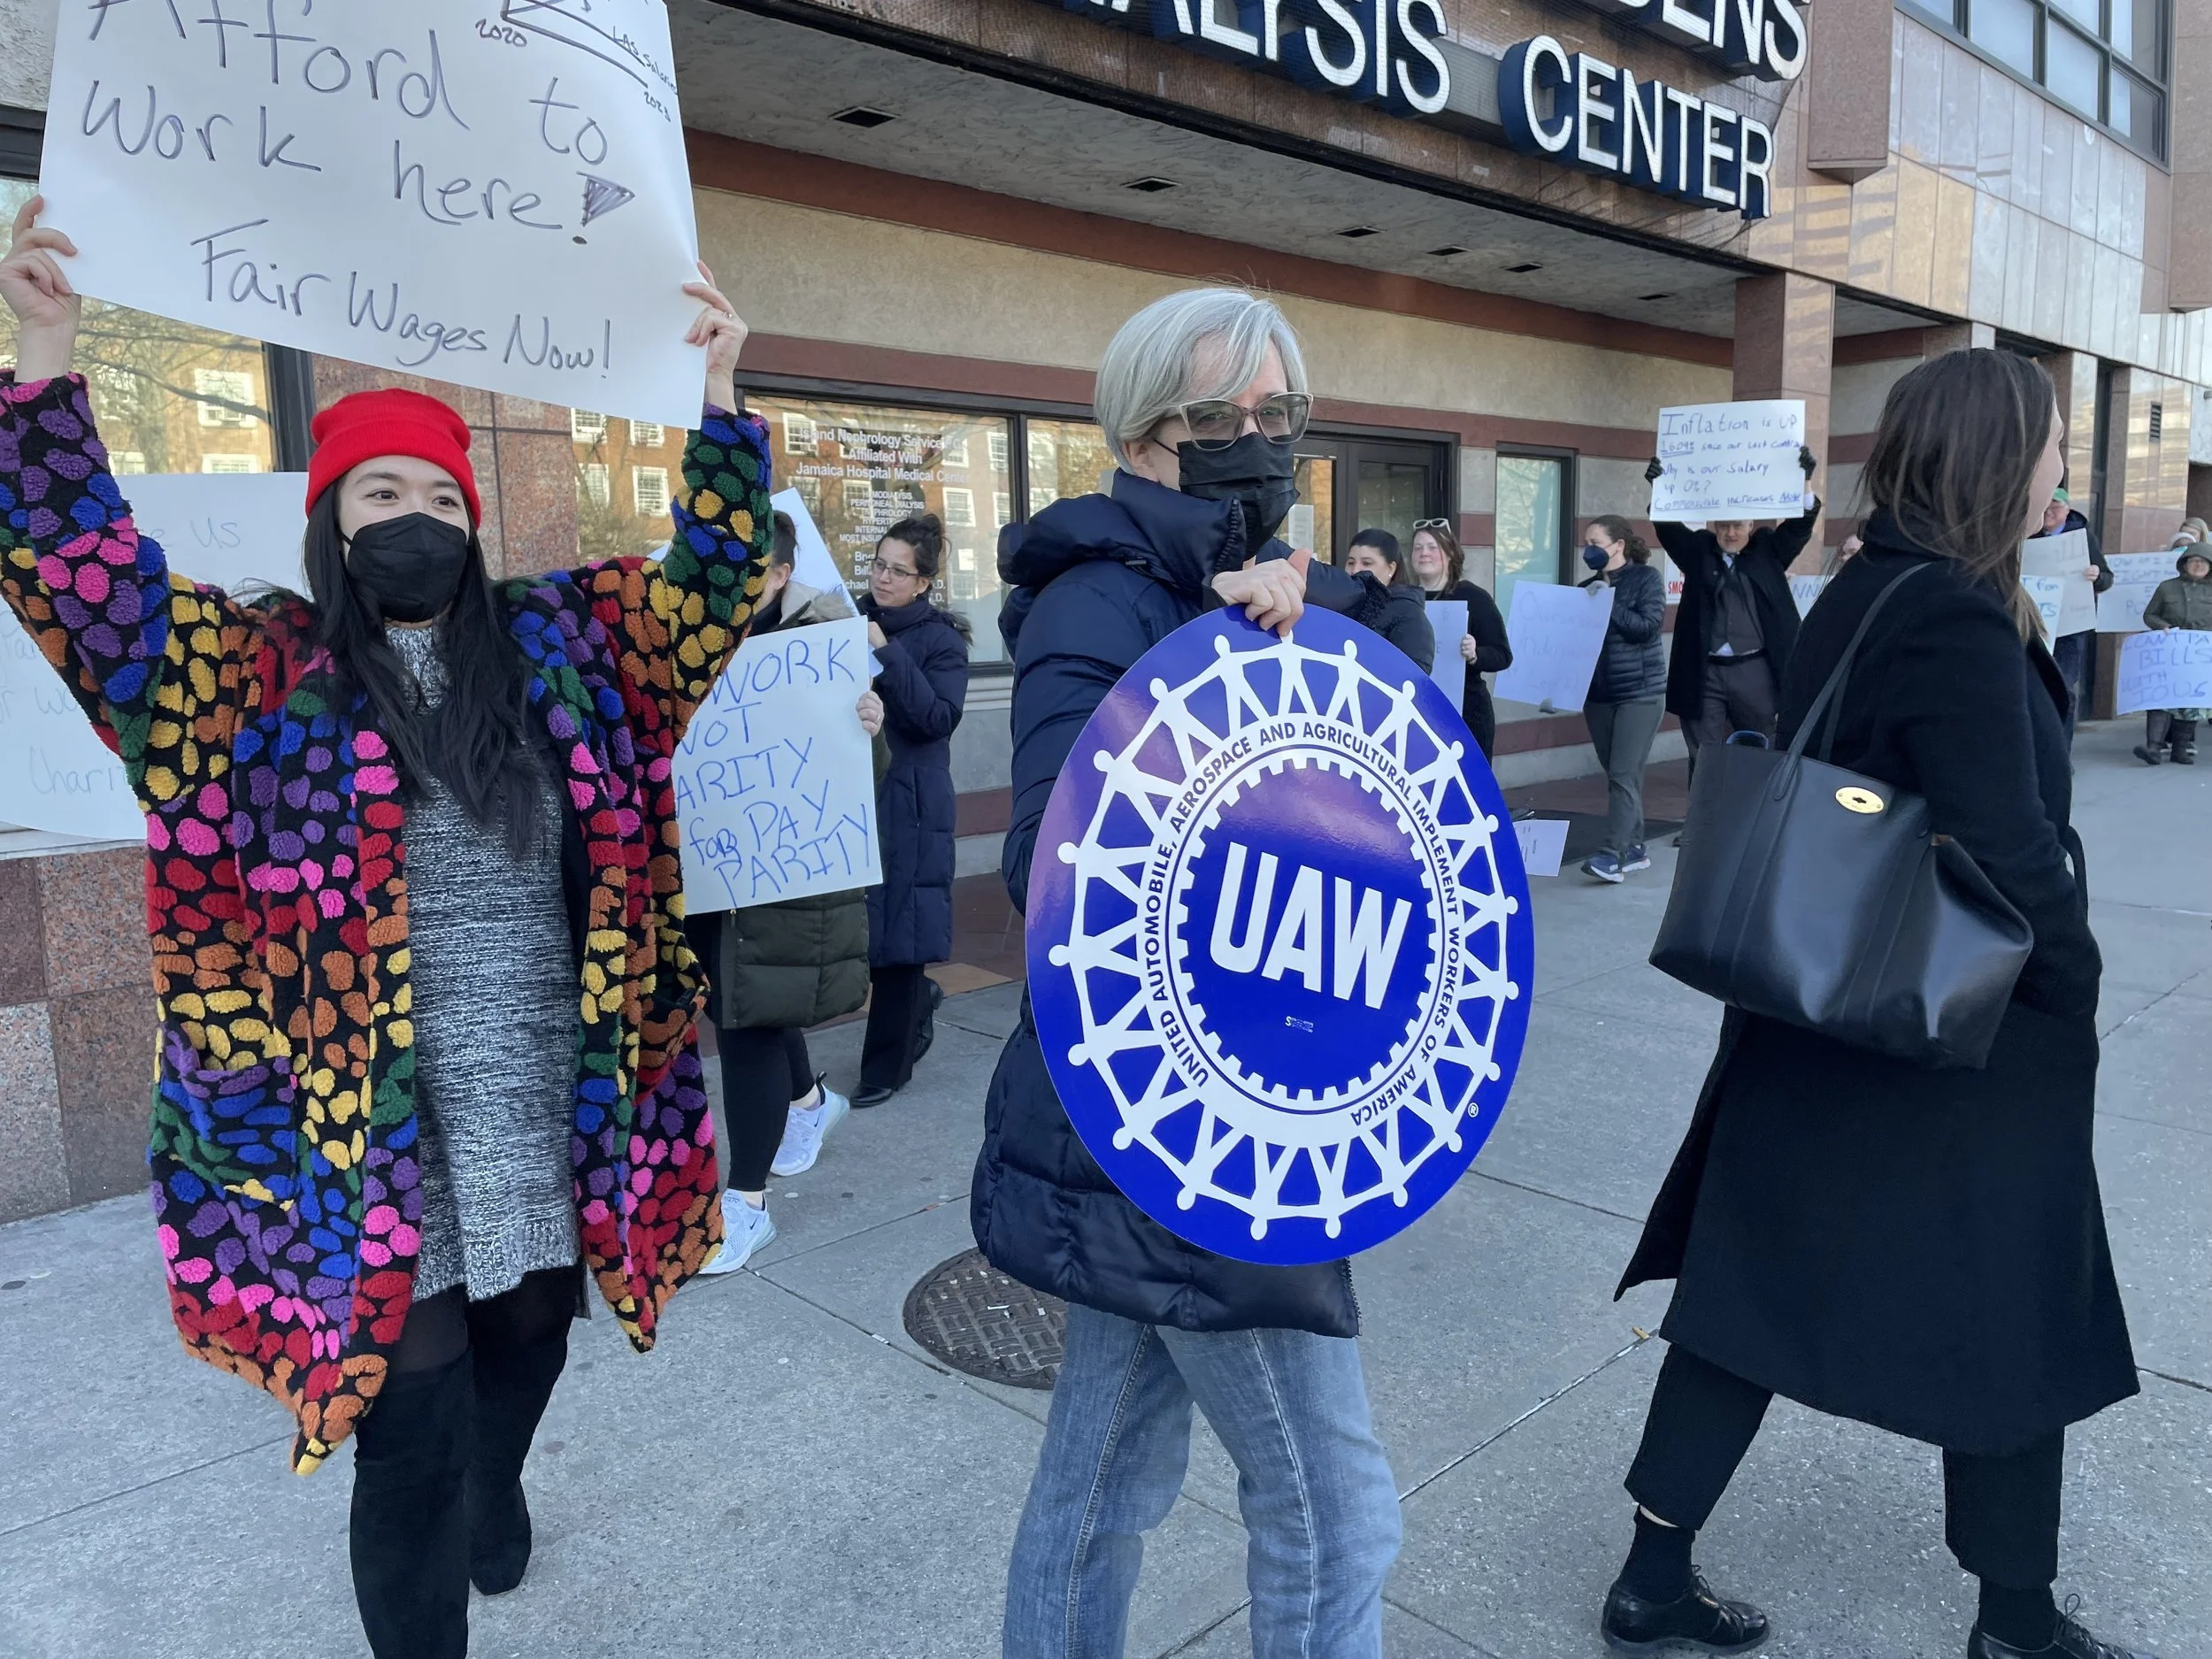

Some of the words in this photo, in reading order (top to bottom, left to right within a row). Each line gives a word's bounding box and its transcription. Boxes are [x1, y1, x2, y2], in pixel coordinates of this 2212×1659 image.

[475, 18, 528, 47] 2020
[81, 80, 321, 172] Work
[529, 76, 608, 165] to
[1520, 35, 1772, 218] CENTER
[189, 219, 331, 316] Fair
[349, 271, 488, 366] Wages
[503, 314, 611, 379] Now!
[838, 429, 901, 449] Nephrology
[849, 449, 895, 463] Affiliated
[897, 452, 923, 465] With
[1662, 412, 1748, 435] Inflation
[796, 463, 844, 477] Jamaica
[847, 465, 891, 480] Hospital
[895, 467, 933, 482] Medical
[28, 742, 127, 795] Chari
[1260, 722, 1295, 746] AND
[1302, 722, 1410, 800] AGRICULTURAL
[675, 737, 812, 818] ARITY
[743, 780, 828, 852] PAY
[1169, 736, 1252, 833] AEROSPACE
[714, 803, 870, 908] PARITY
[1412, 800, 1459, 915] IMPLEMENT
[1144, 841, 1178, 1002] AUTOMOBILE,
[1210, 841, 1411, 1010] UAW
[1434, 926, 1460, 1029] WORKERS
[1160, 1010, 1210, 1087] UNITED
[1420, 1034, 1437, 1063] OF
[1350, 1064, 1417, 1126] AMERICA
